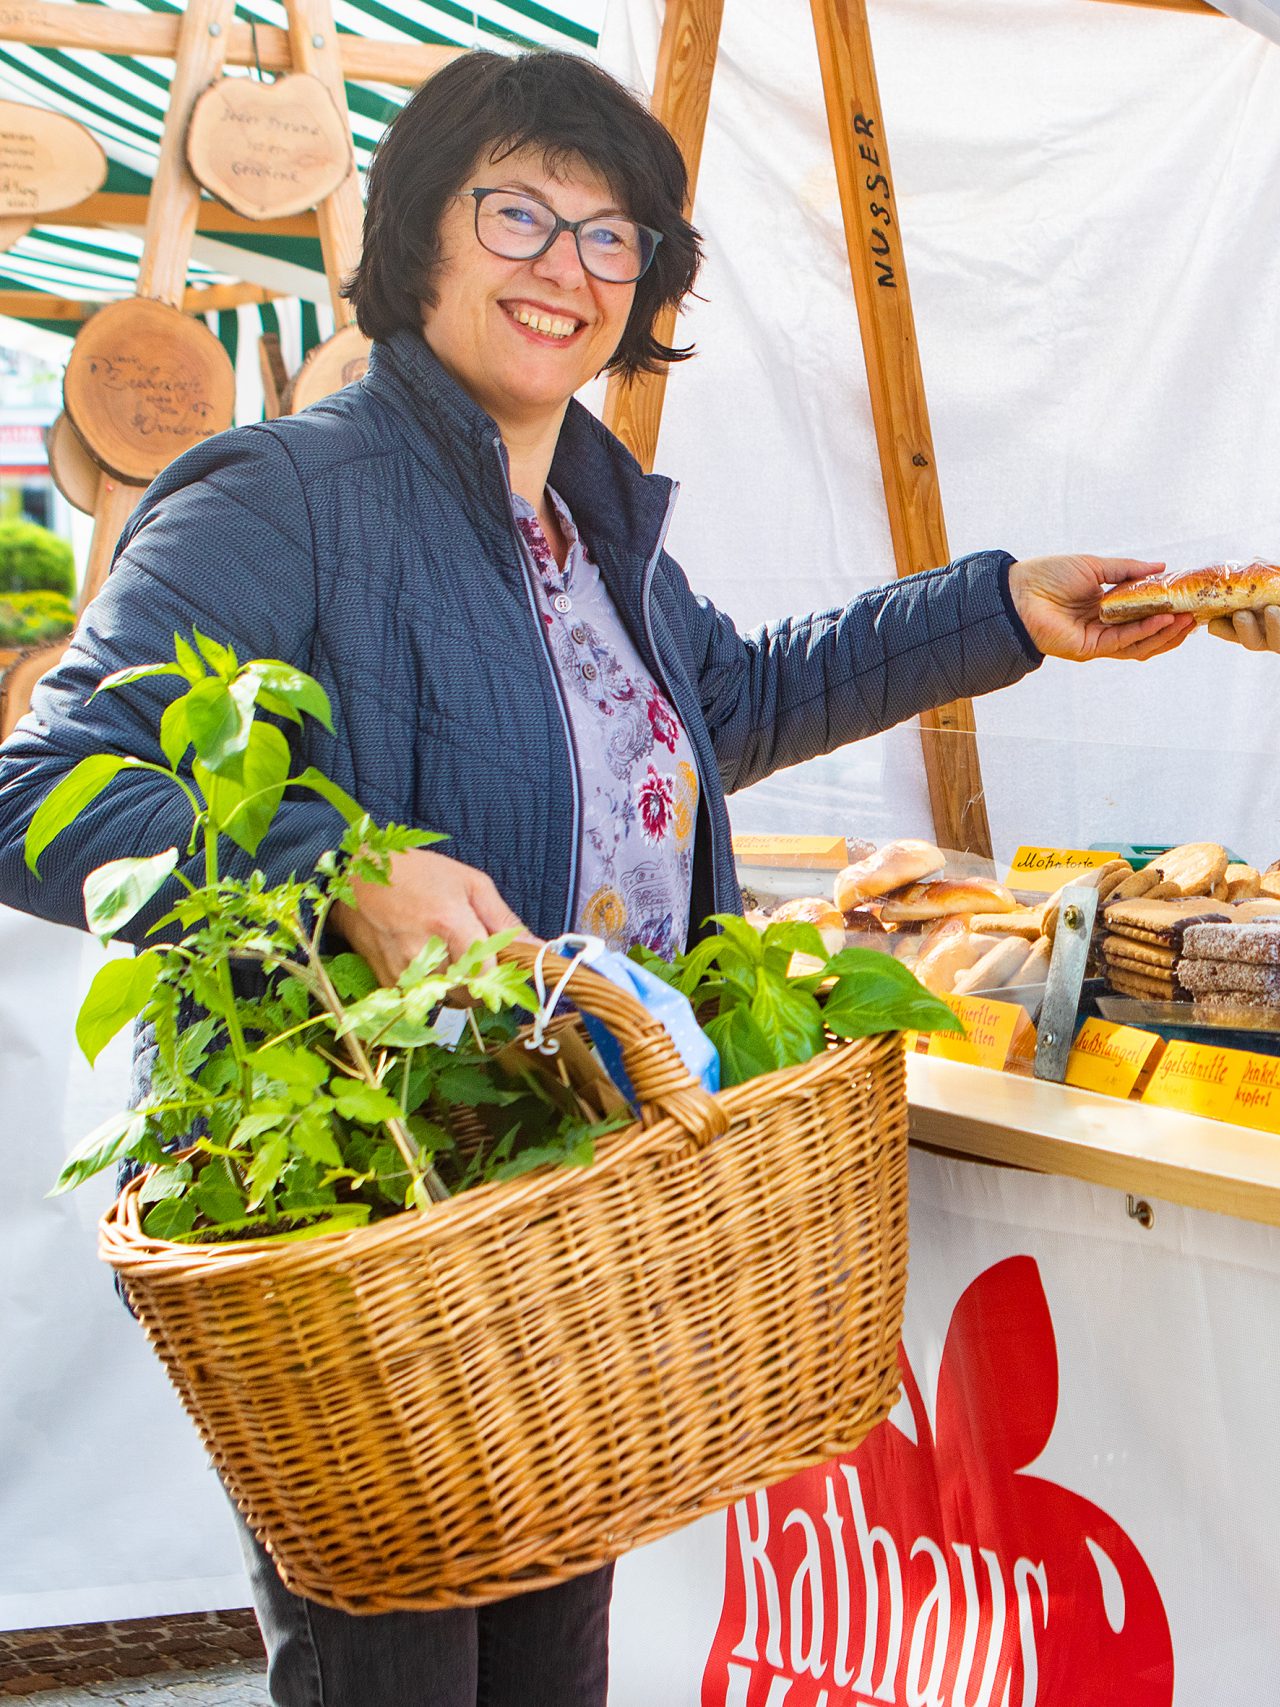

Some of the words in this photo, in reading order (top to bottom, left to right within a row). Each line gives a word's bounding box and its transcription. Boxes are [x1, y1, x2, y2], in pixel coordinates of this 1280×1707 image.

[853, 111, 898, 288] NUSSER
[1234, 1087, 1273, 1108] kipferl
[731, 1463, 1049, 1707] Rathaus
